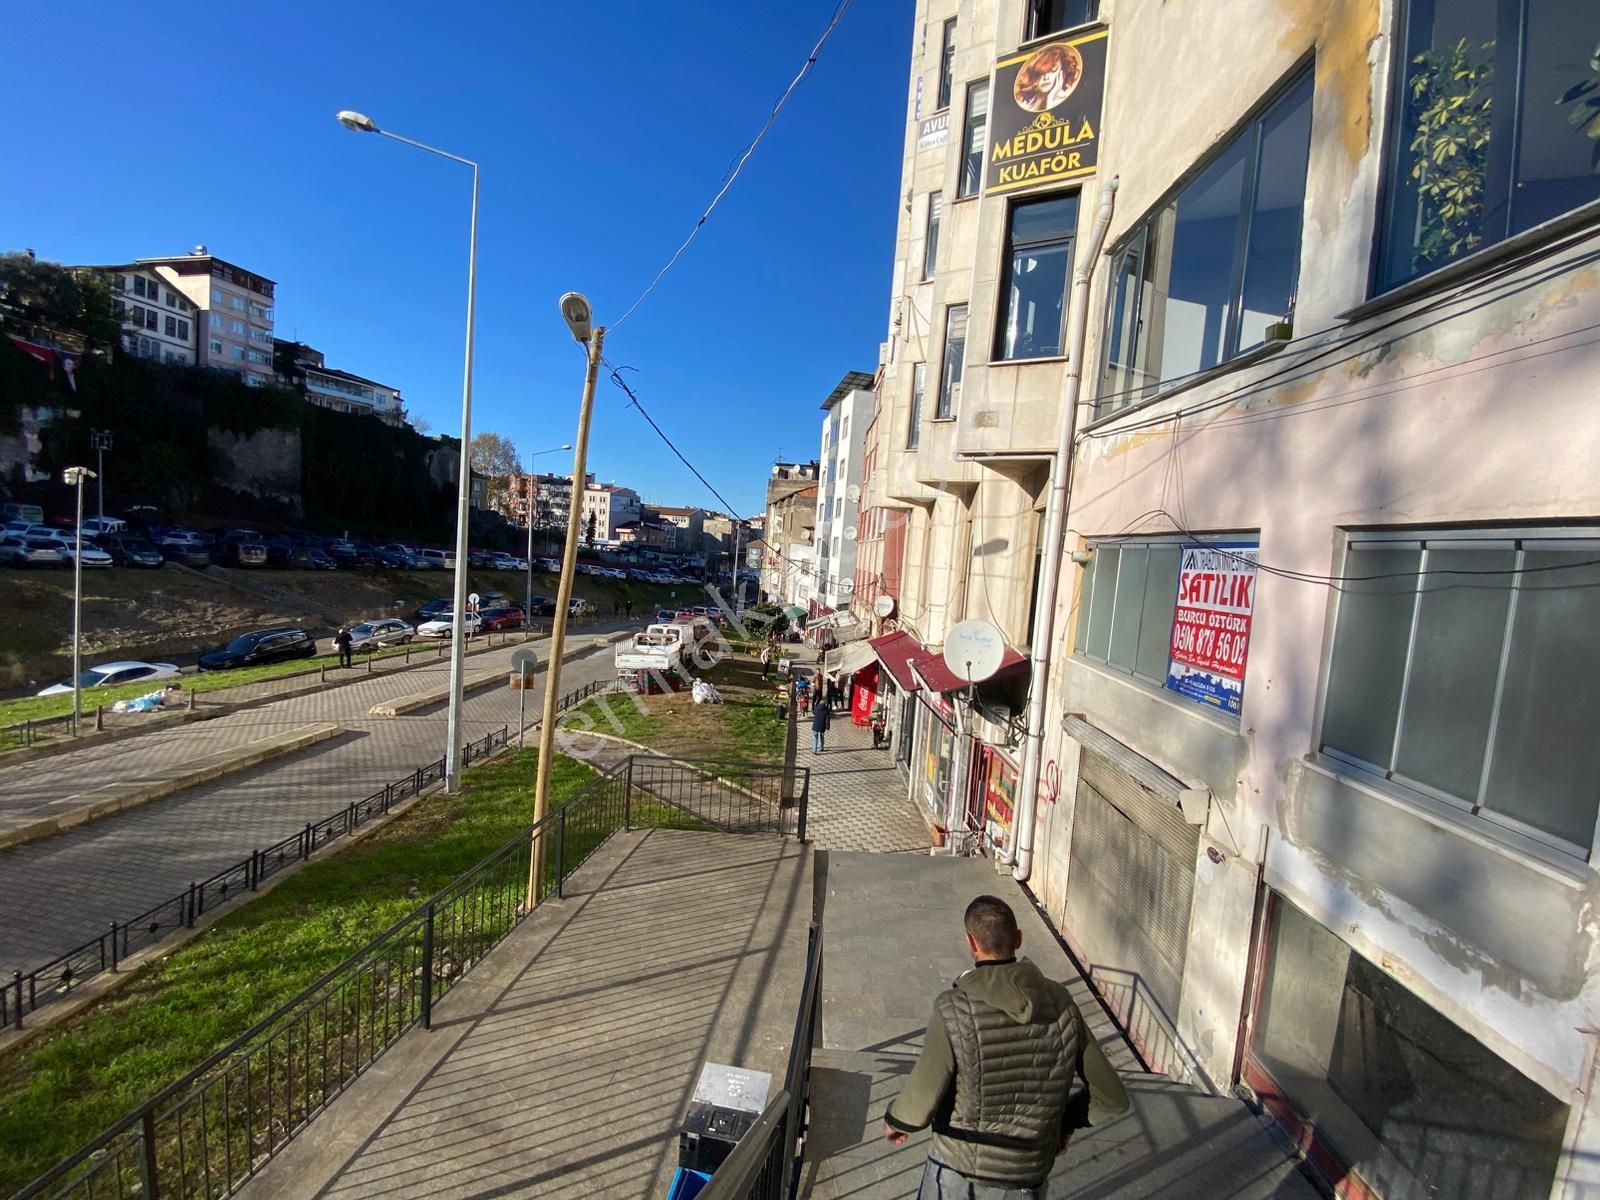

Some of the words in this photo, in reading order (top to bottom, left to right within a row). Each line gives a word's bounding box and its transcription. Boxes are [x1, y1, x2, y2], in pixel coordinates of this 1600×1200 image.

[992, 120, 1096, 162] MEDULA
[999, 151, 1081, 184] KUAFÖR
[1180, 573, 1254, 609] SATILIK
[1178, 610, 1206, 626] BURCU
[1209, 612, 1247, 633] ÖZTÜRK
[1196, 628, 1216, 658] 878
[1215, 632, 1231, 662] 56
[1231, 635, 1247, 666] 02
